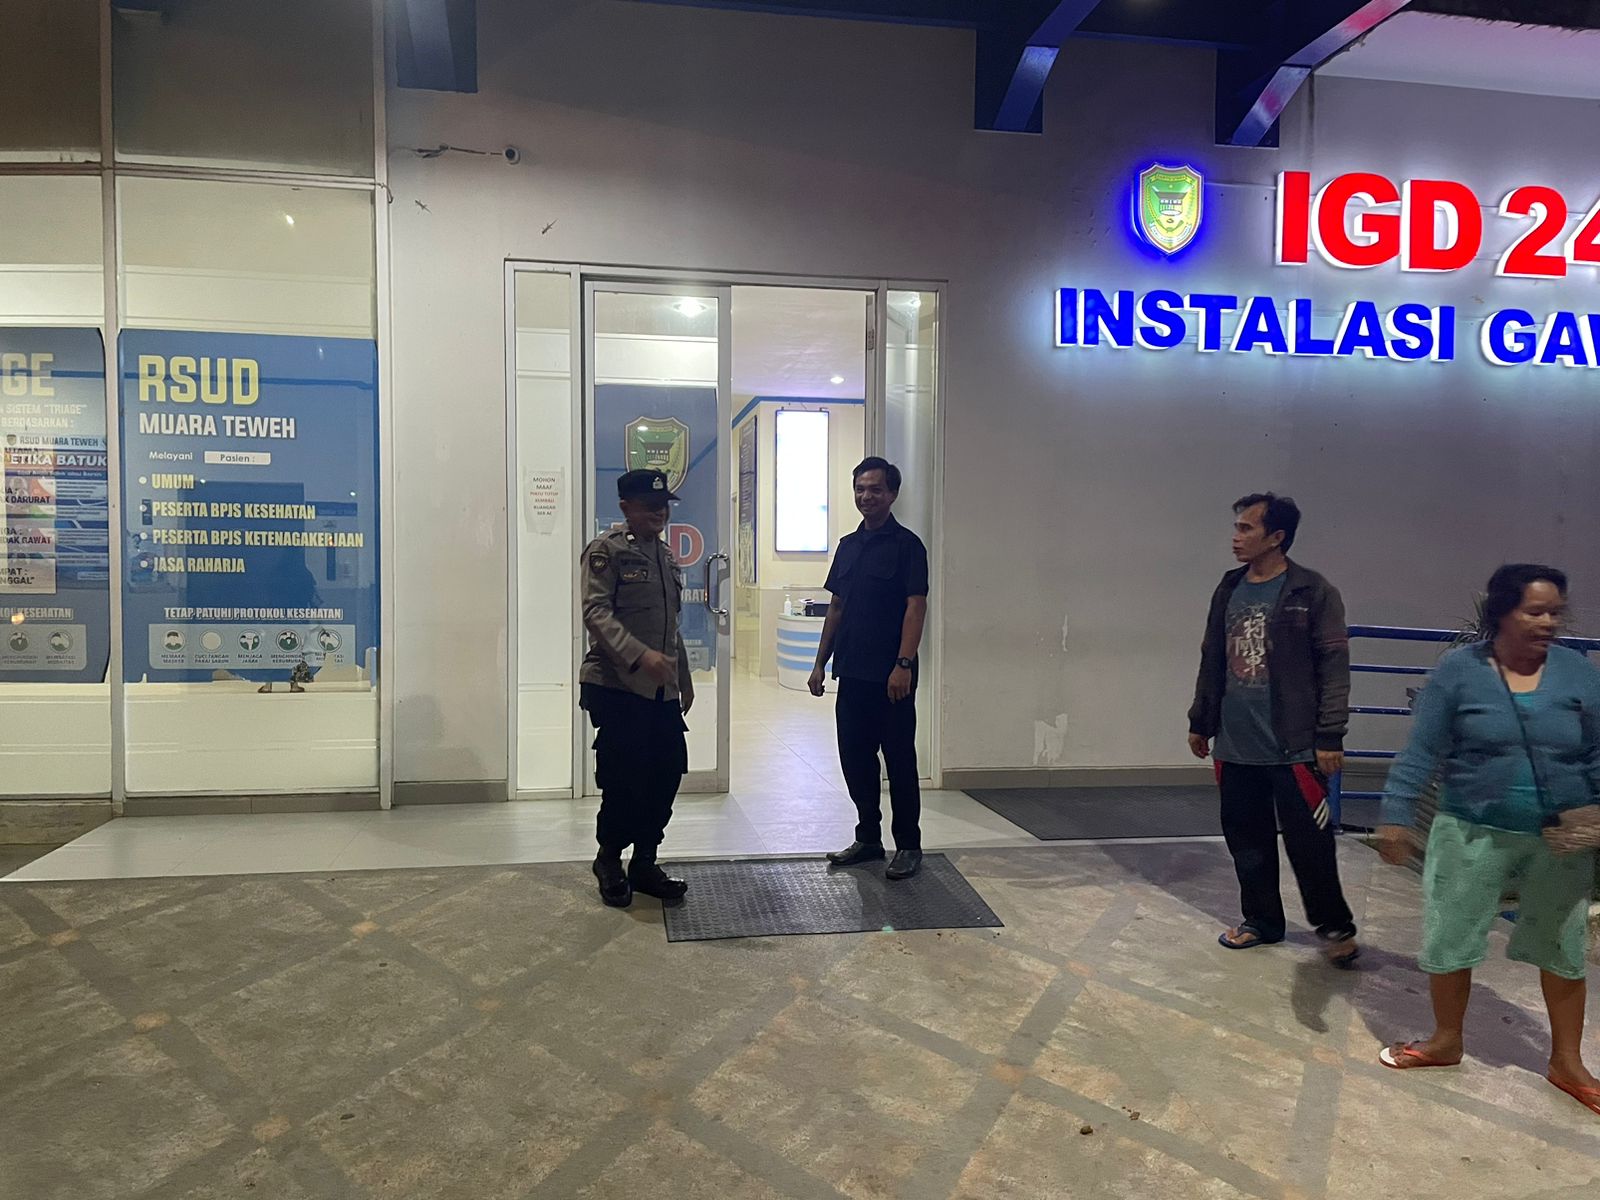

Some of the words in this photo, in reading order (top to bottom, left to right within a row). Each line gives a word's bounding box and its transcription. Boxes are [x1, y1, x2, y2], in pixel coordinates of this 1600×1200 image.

[1276, 170, 1483, 273] IGD
[1056, 288, 1455, 362] INSTALASI
[1481, 309, 1600, 369] GA
[139, 355, 259, 405] RSUD
[139, 412, 217, 436] MUARA
[222, 415, 295, 438] TEWEH
[70, 438, 99, 446] TEWEH
[11, 454, 53, 465] ETIKA
[57, 455, 107, 466] BATUK
[149, 451, 193, 461] Melayani
[220, 454, 250, 462] Pasien
[152, 473, 194, 489] UMUM
[11, 496, 51, 504] DARURAT
[152, 501, 208, 517] PESERTA
[210, 502, 242, 517] BPJS
[244, 503, 316, 519] KESEHATAN
[153, 529, 208, 545] PESERTA
[210, 530, 242, 545] BPJS
[244, 531, 364, 547] KETENAGAKERJAAN
[153, 557, 185, 572] JASA
[187, 557, 246, 572] RAHARJA
[164, 607, 194, 619] TETAP
[196, 607, 231, 619] PATUHI
[233, 607, 284, 619] PROTOKOL
[286, 608, 341, 619] KESEHATAN
